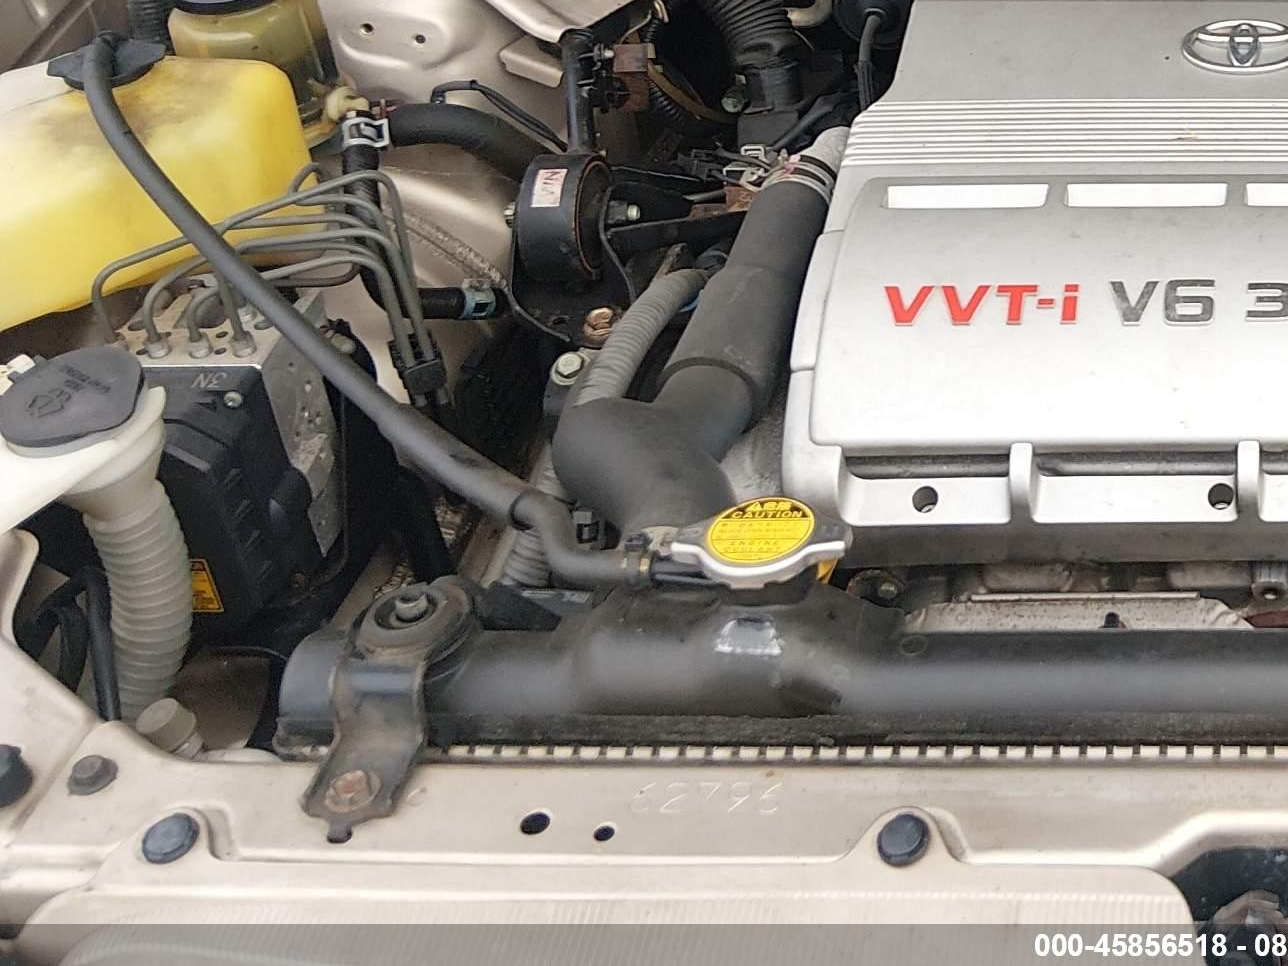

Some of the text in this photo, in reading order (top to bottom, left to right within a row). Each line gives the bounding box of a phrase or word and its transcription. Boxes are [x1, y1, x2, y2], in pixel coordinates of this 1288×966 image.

[884, 283, 1081, 326] VVT-i
[1110, 279, 1217, 326] V6
[731, 510, 804, 519] CAUTION
